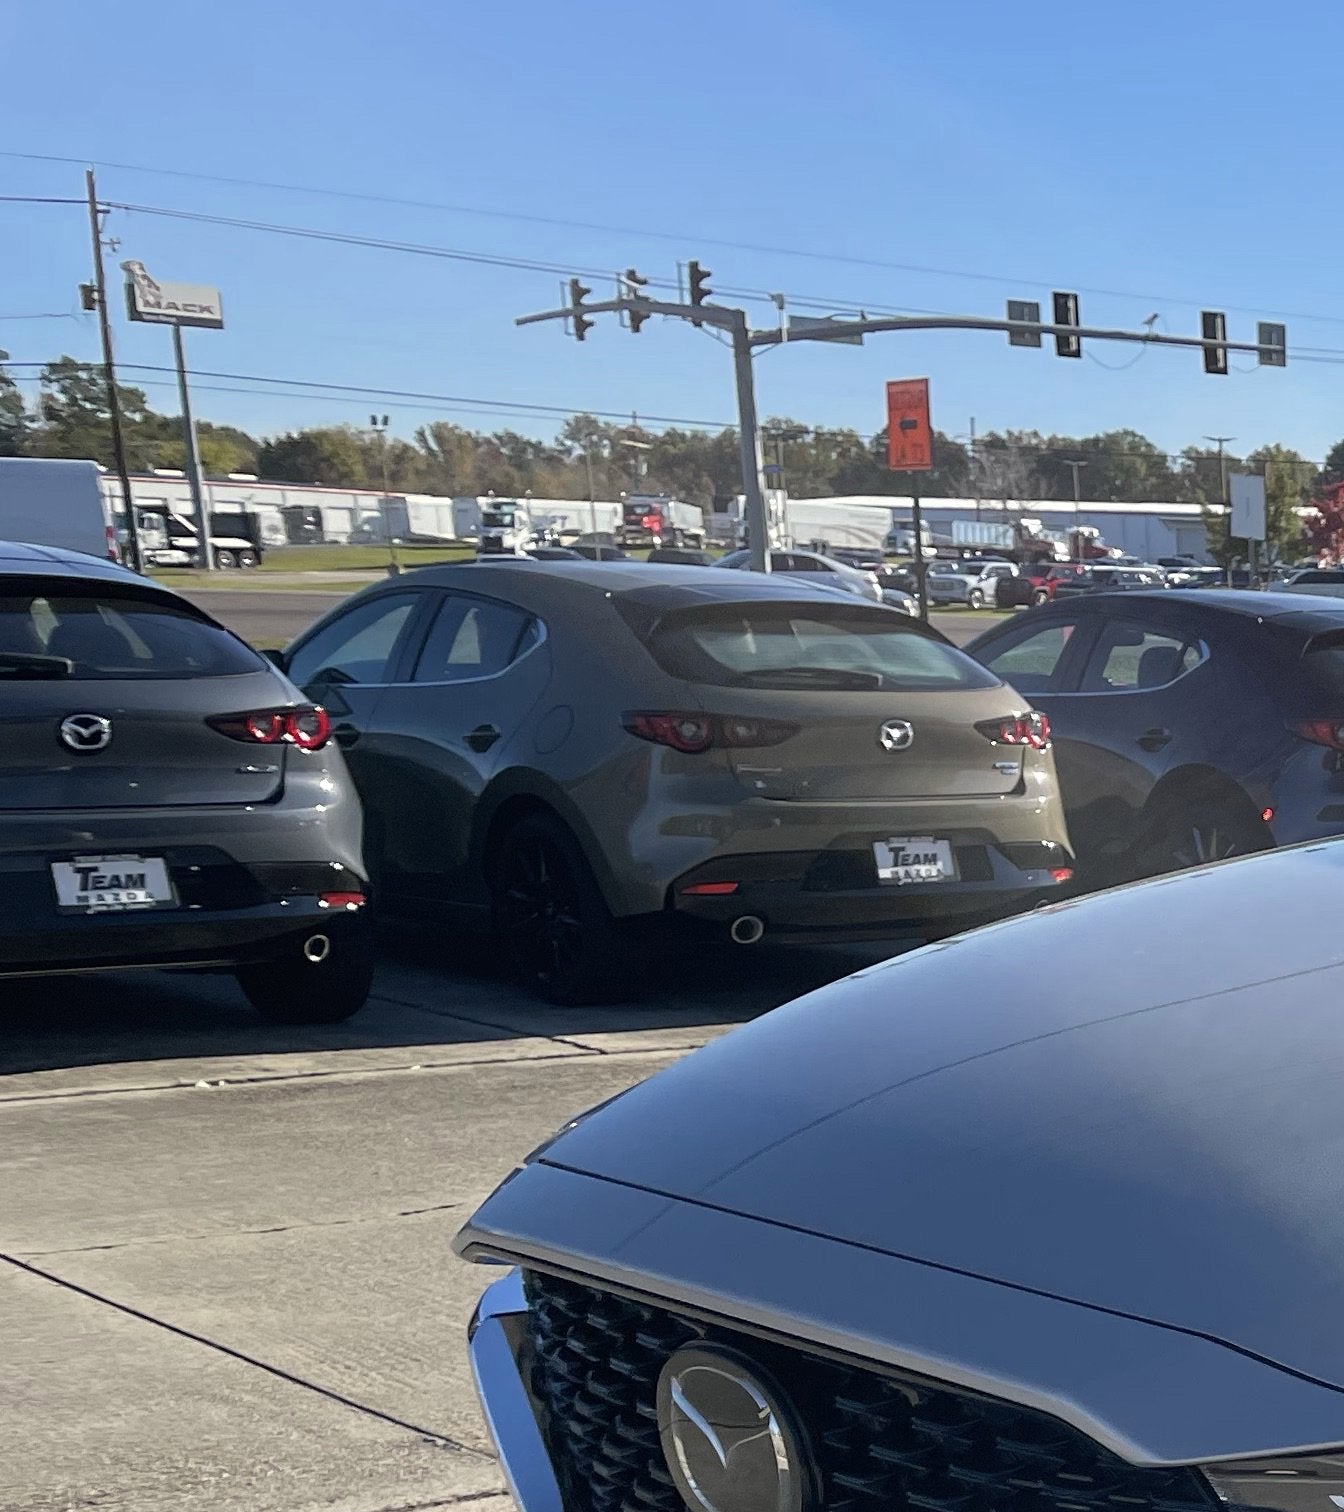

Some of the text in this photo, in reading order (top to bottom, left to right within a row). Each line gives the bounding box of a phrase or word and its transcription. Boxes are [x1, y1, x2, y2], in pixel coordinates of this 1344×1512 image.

[142, 299, 215, 315] MACK
[887, 846, 938, 868] TEAM
[73, 865, 146, 892] TEAM
